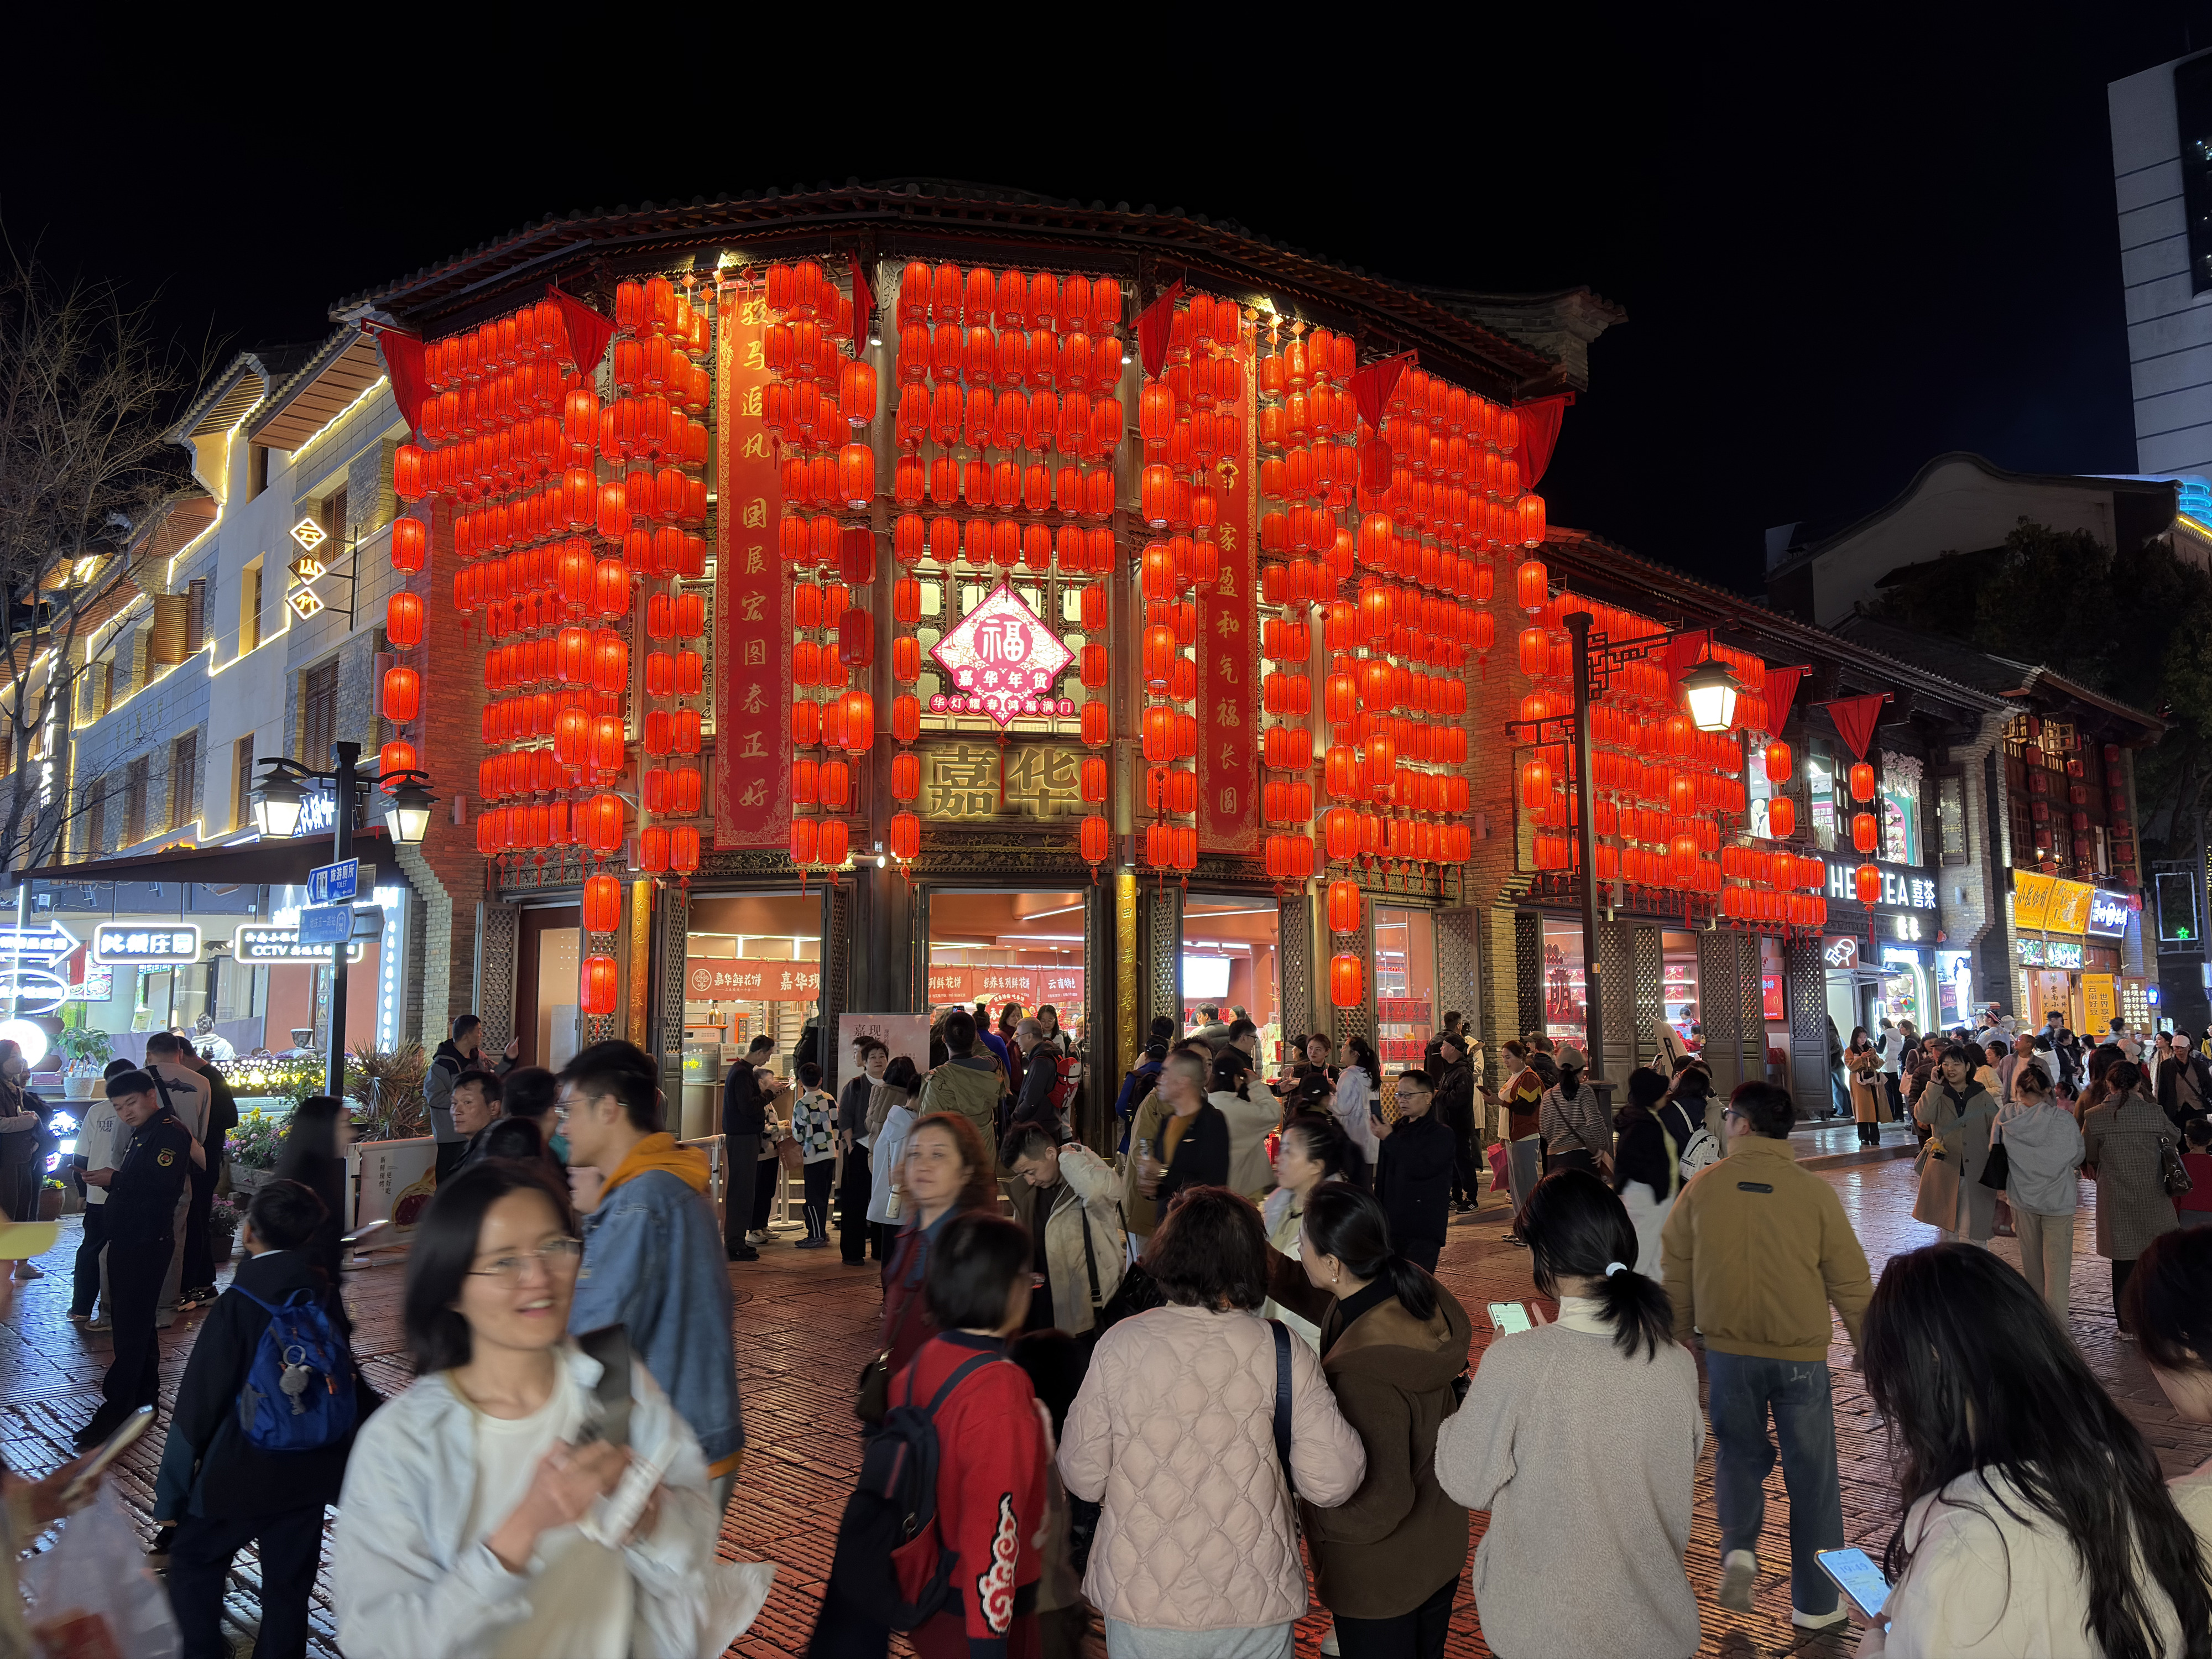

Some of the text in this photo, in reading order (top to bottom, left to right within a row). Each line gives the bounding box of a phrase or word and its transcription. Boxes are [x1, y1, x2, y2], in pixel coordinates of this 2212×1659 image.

[981, 618, 1025, 663] 福
[958, 669, 1049, 690] 嘉华年货
[933, 696, 1072, 714] 华灯耀春鸿福满门
[928, 745, 1079, 818] 嘉华
[330, 863, 355, 883] 旅游厕所
[336, 880, 348, 888] TOILET
[1912, 878, 1937, 910] 喜茶
[252, 945, 288, 956] CCTV
[714, 972, 761, 987] 嘉华鲜花饼
[780, 971, 820, 992] 嘉华现
[928, 976, 962, 989] 列鲜花饼
[983, 975, 1030, 989] 轻养系列鲜花饼
[1048, 977, 1076, 989] 云南特色
[2050, 985, 2059, 1013] 雲南小
[2088, 985, 2099, 1015] 云南好豆
[2100, 993, 2110, 1023] 世界享受
